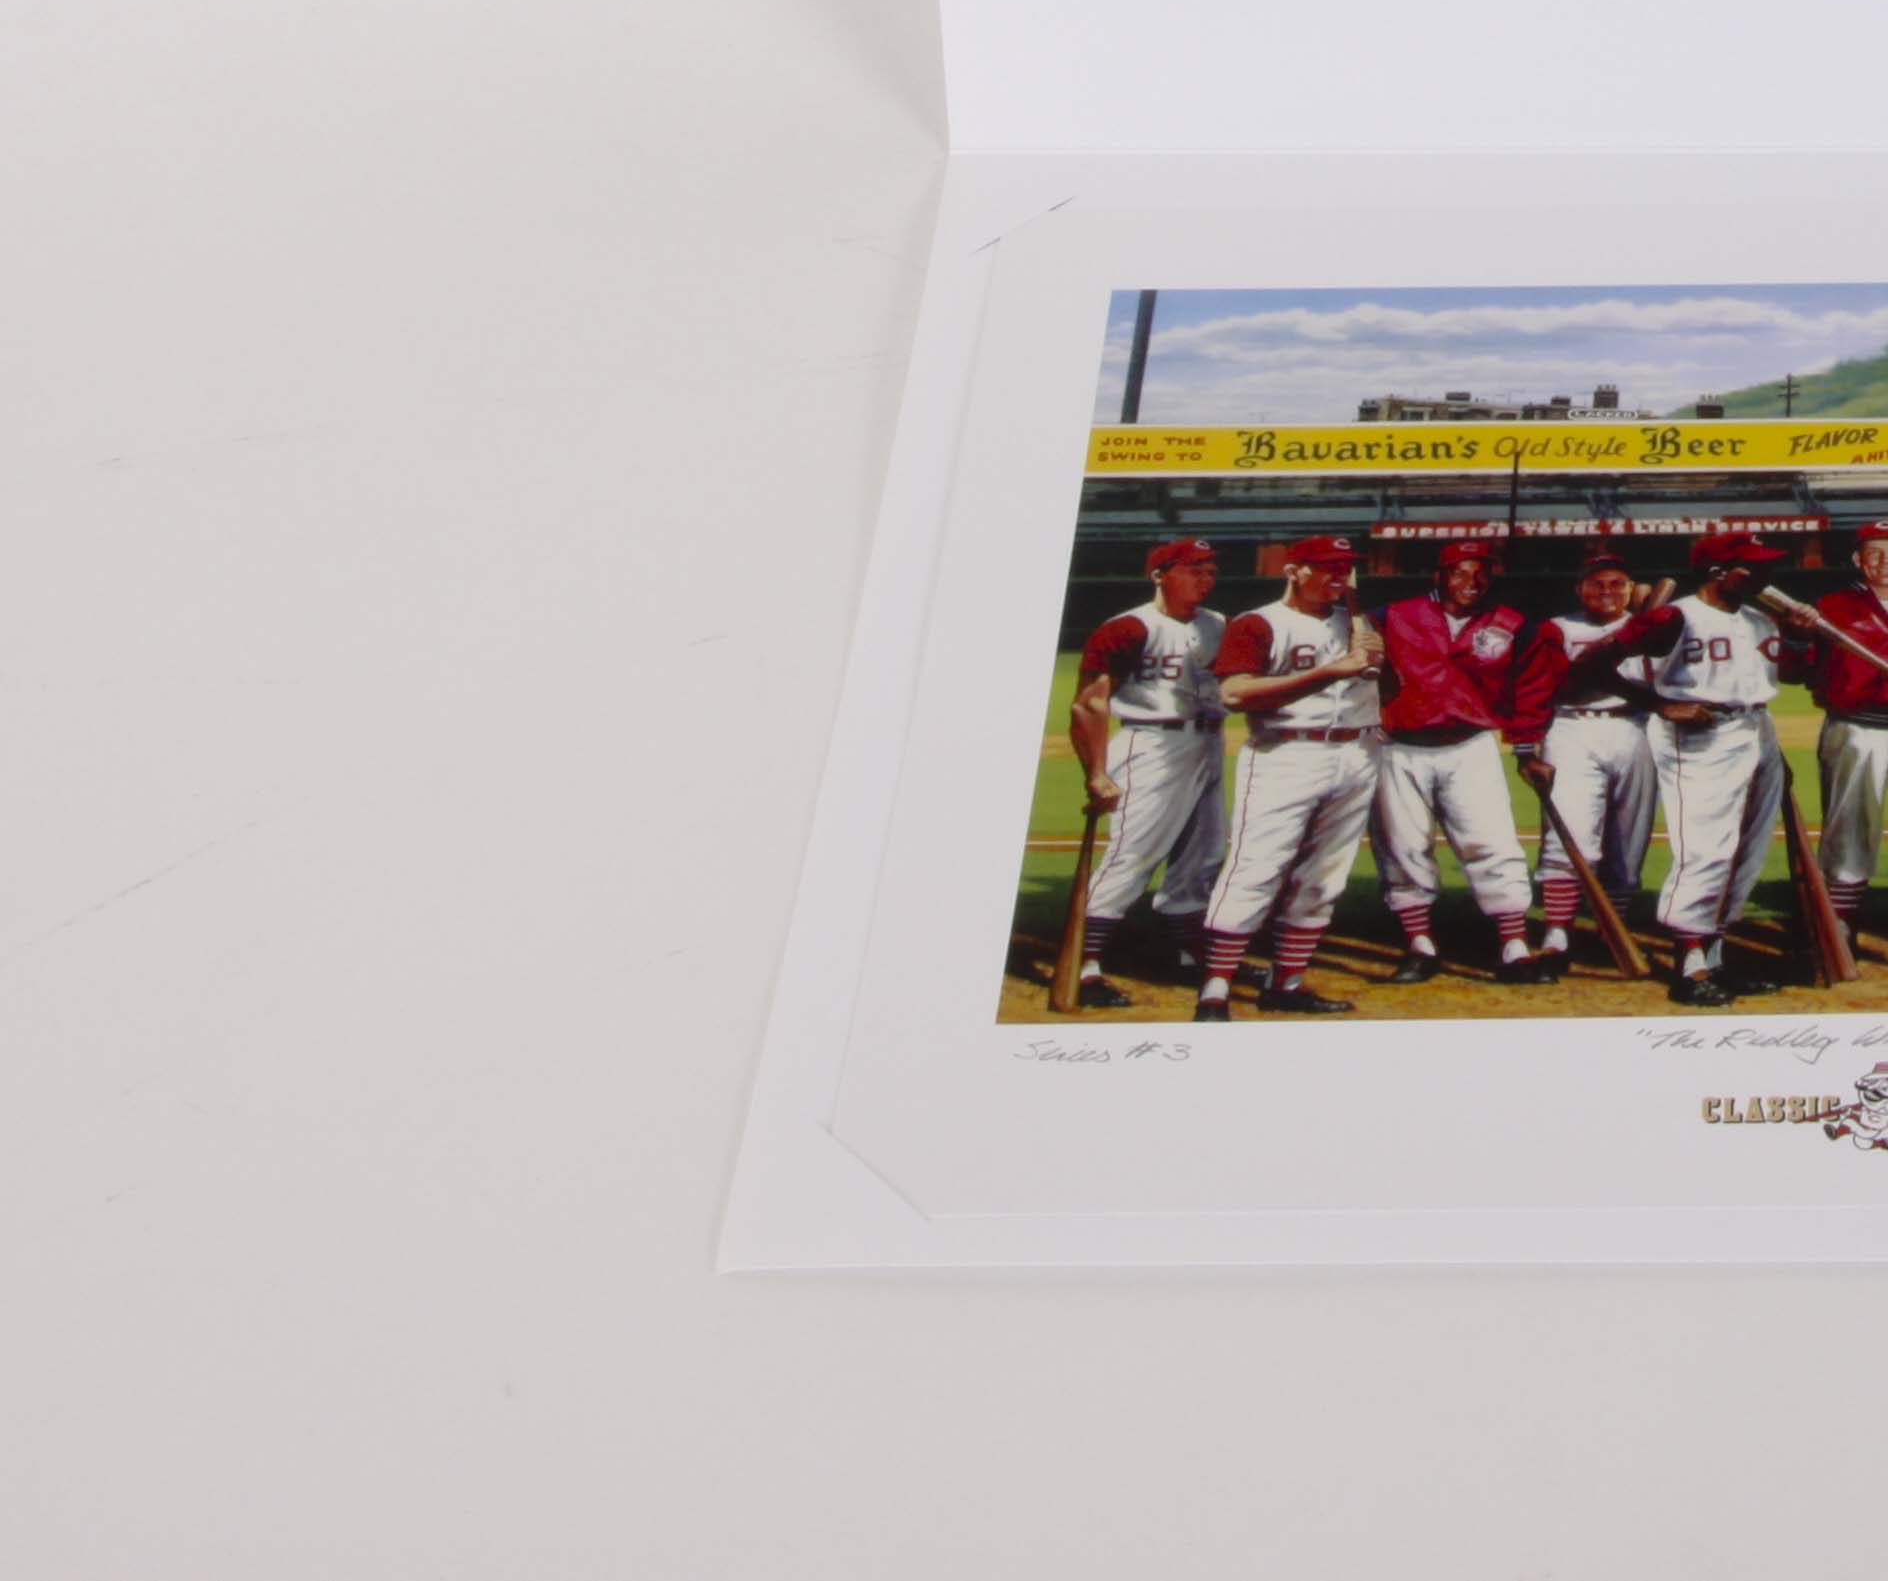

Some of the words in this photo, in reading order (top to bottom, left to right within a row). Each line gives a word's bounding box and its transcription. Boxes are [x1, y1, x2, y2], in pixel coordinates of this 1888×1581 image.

[1100, 436, 1149, 447] JOIN
[1162, 436, 1207, 447] THE
[1233, 429, 1481, 469] Bavarian's
[1493, 435, 1552, 459] Old
[1554, 435, 1628, 463] Style
[1638, 426, 1747, 465] Beer
[1788, 427, 1879, 457] FLAVOR
[1097, 450, 1165, 463] SWING
[1176, 450, 1202, 462] TO
[1682, 636, 1732, 663] 20
[1699, 1091, 1842, 1125] CLASSIC
